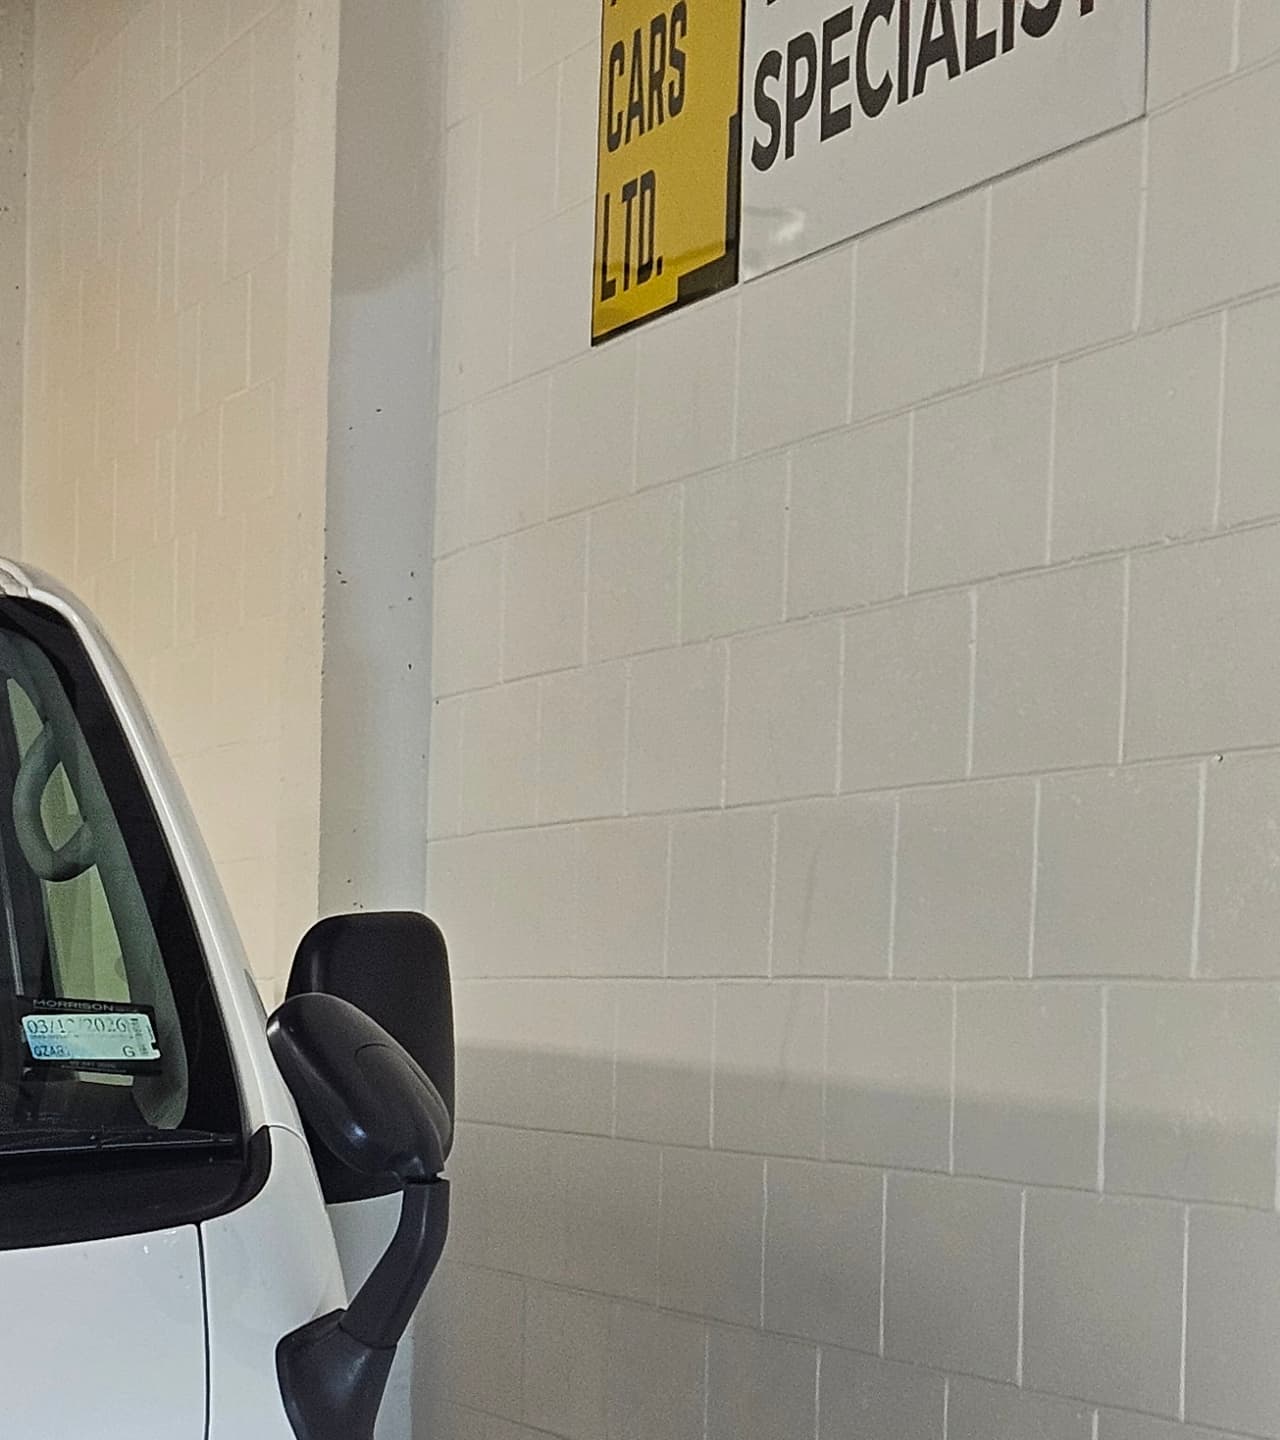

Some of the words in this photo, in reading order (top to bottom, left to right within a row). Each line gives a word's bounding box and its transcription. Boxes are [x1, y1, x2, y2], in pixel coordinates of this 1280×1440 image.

[608, 0, 687, 152] CARS
[751, 0, 1095, 171] SPECIAL
[601, 169, 663, 302] LTD.
[26, 1017, 127, 1034] 03/12026
[32, 999, 114, 1012] MORRISON
